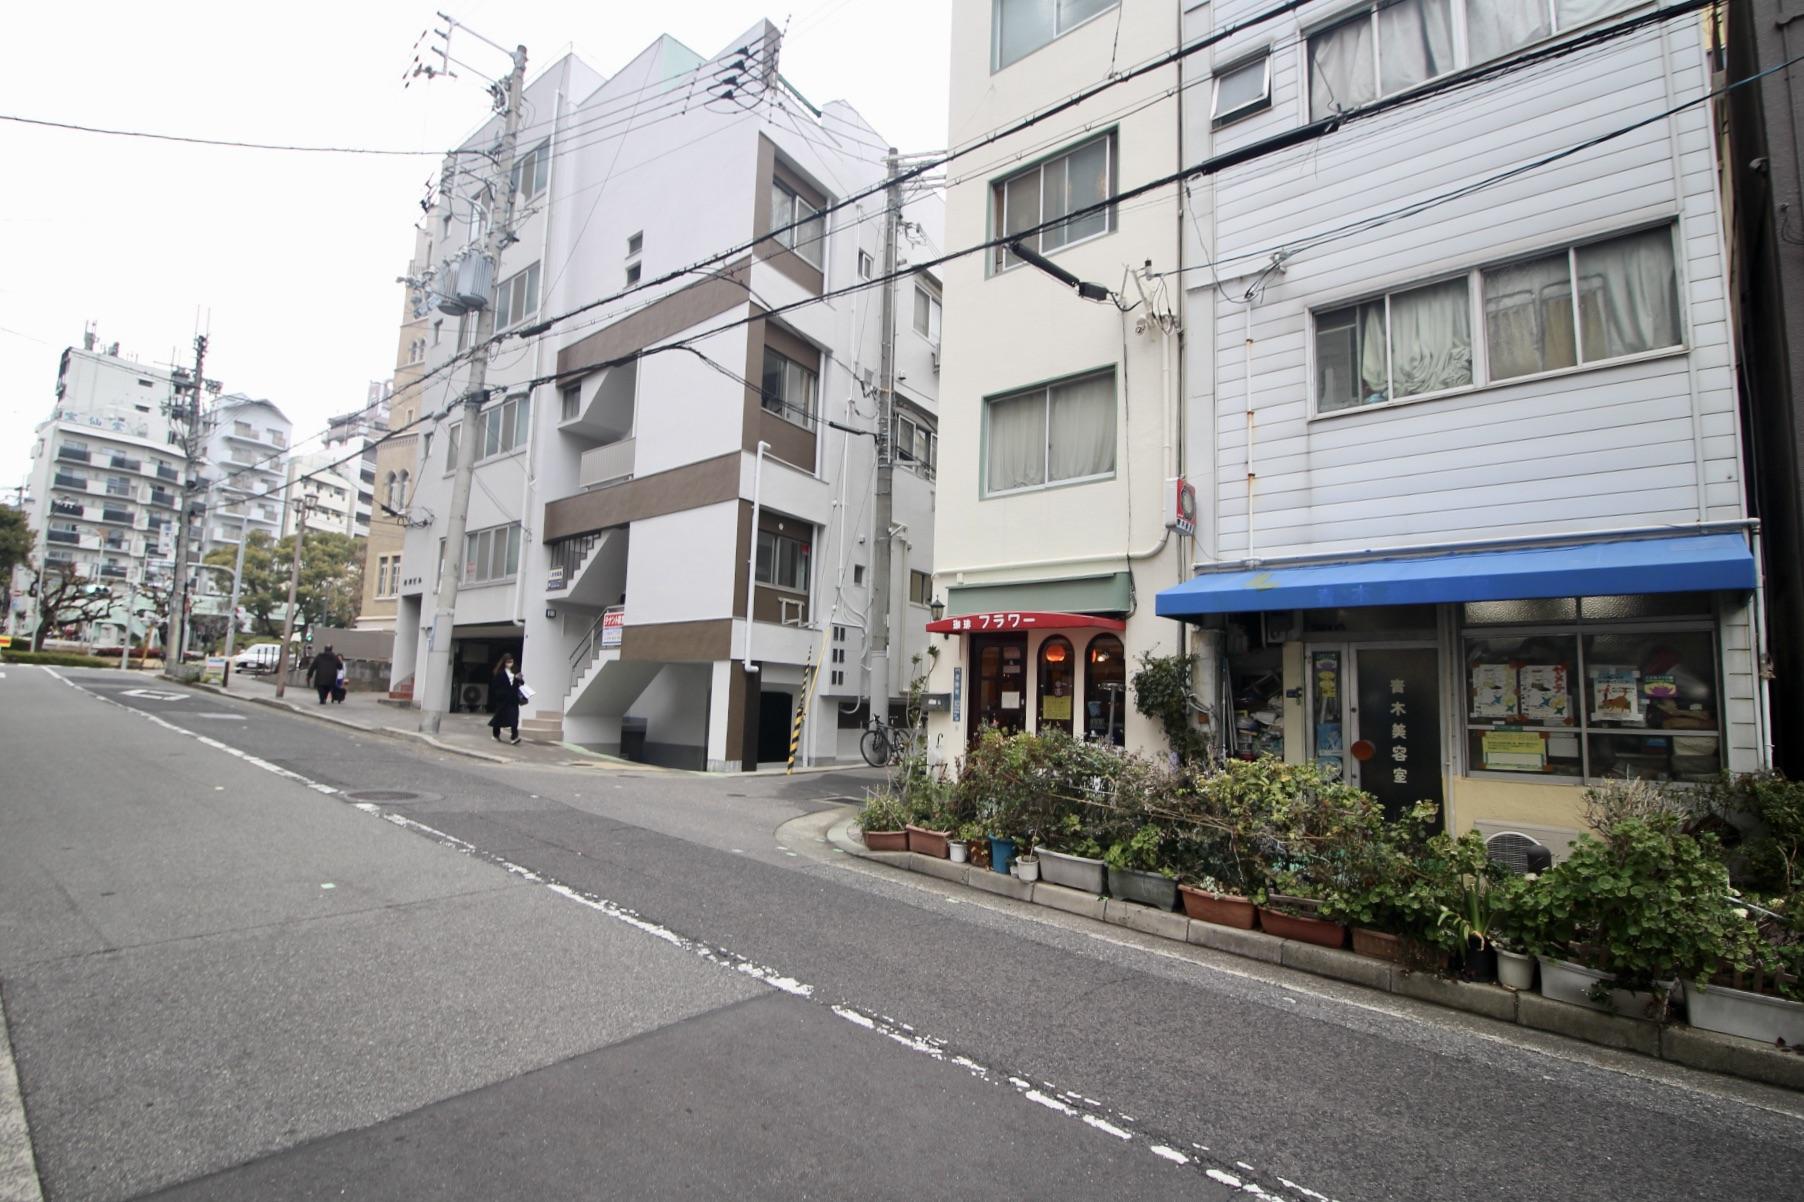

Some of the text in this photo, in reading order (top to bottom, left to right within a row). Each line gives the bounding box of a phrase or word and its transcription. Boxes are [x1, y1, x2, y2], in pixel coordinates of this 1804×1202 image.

[952, 613, 1036, 630] 珈琲 フラワー
[1389, 677, 1409, 784] 青木美容室
